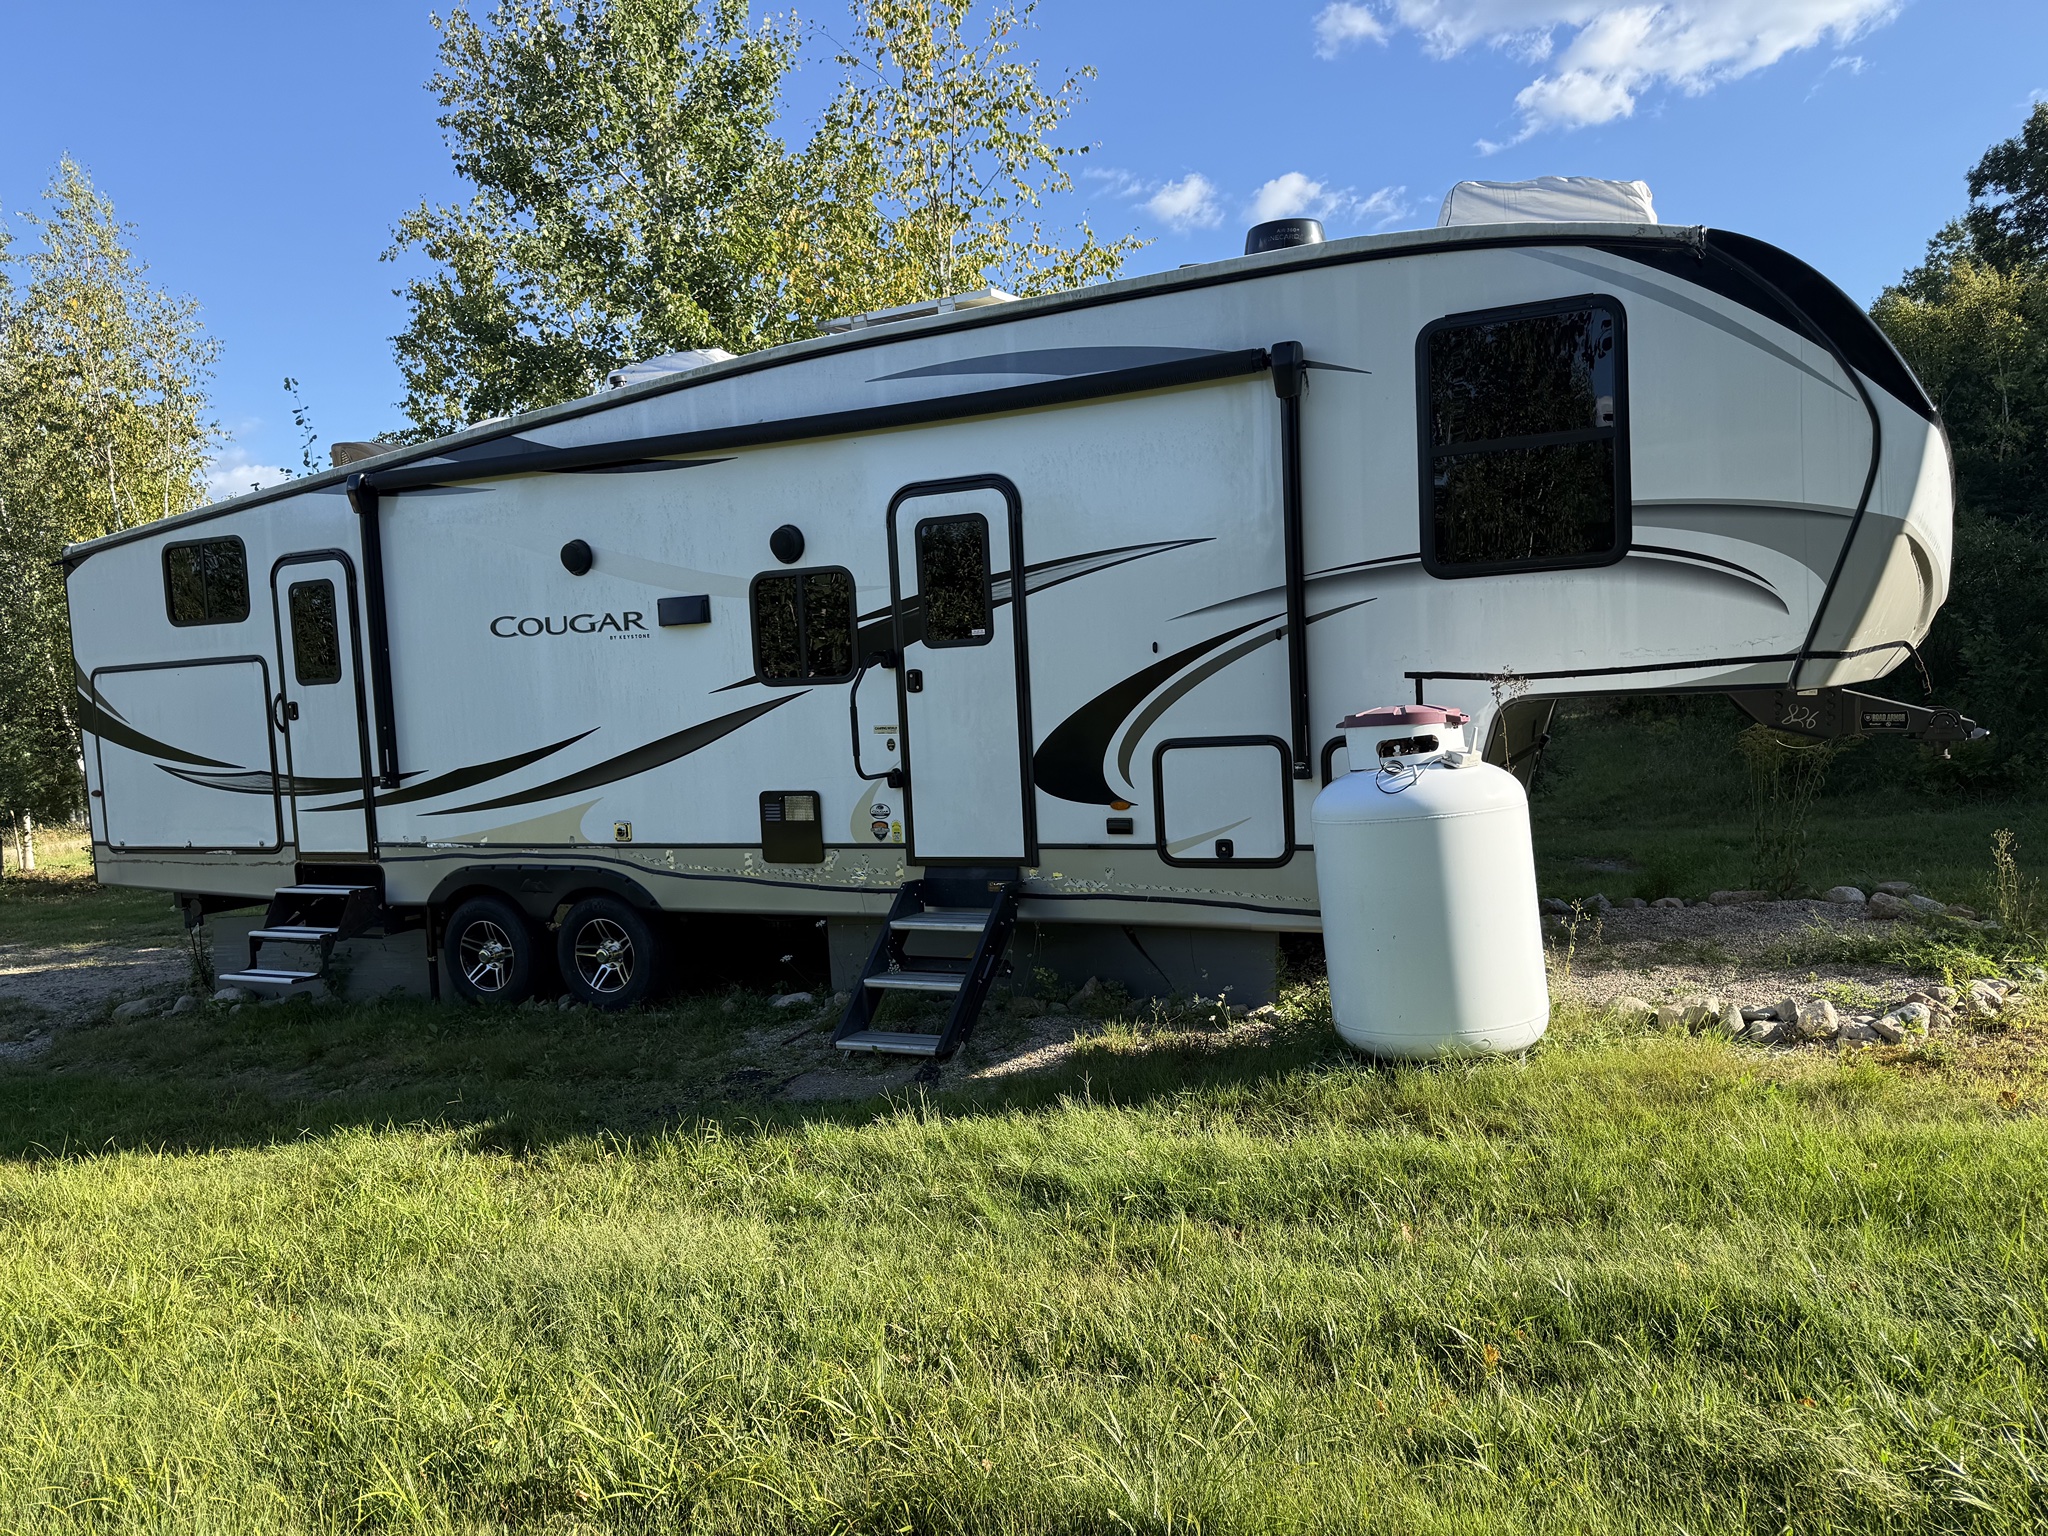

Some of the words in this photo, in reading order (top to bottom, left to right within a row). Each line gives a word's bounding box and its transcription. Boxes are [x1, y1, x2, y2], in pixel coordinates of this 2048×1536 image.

[489, 611, 649, 638] COUGAR
[1781, 703, 1819, 729] 826
[1872, 713, 1886, 721] ROAD
